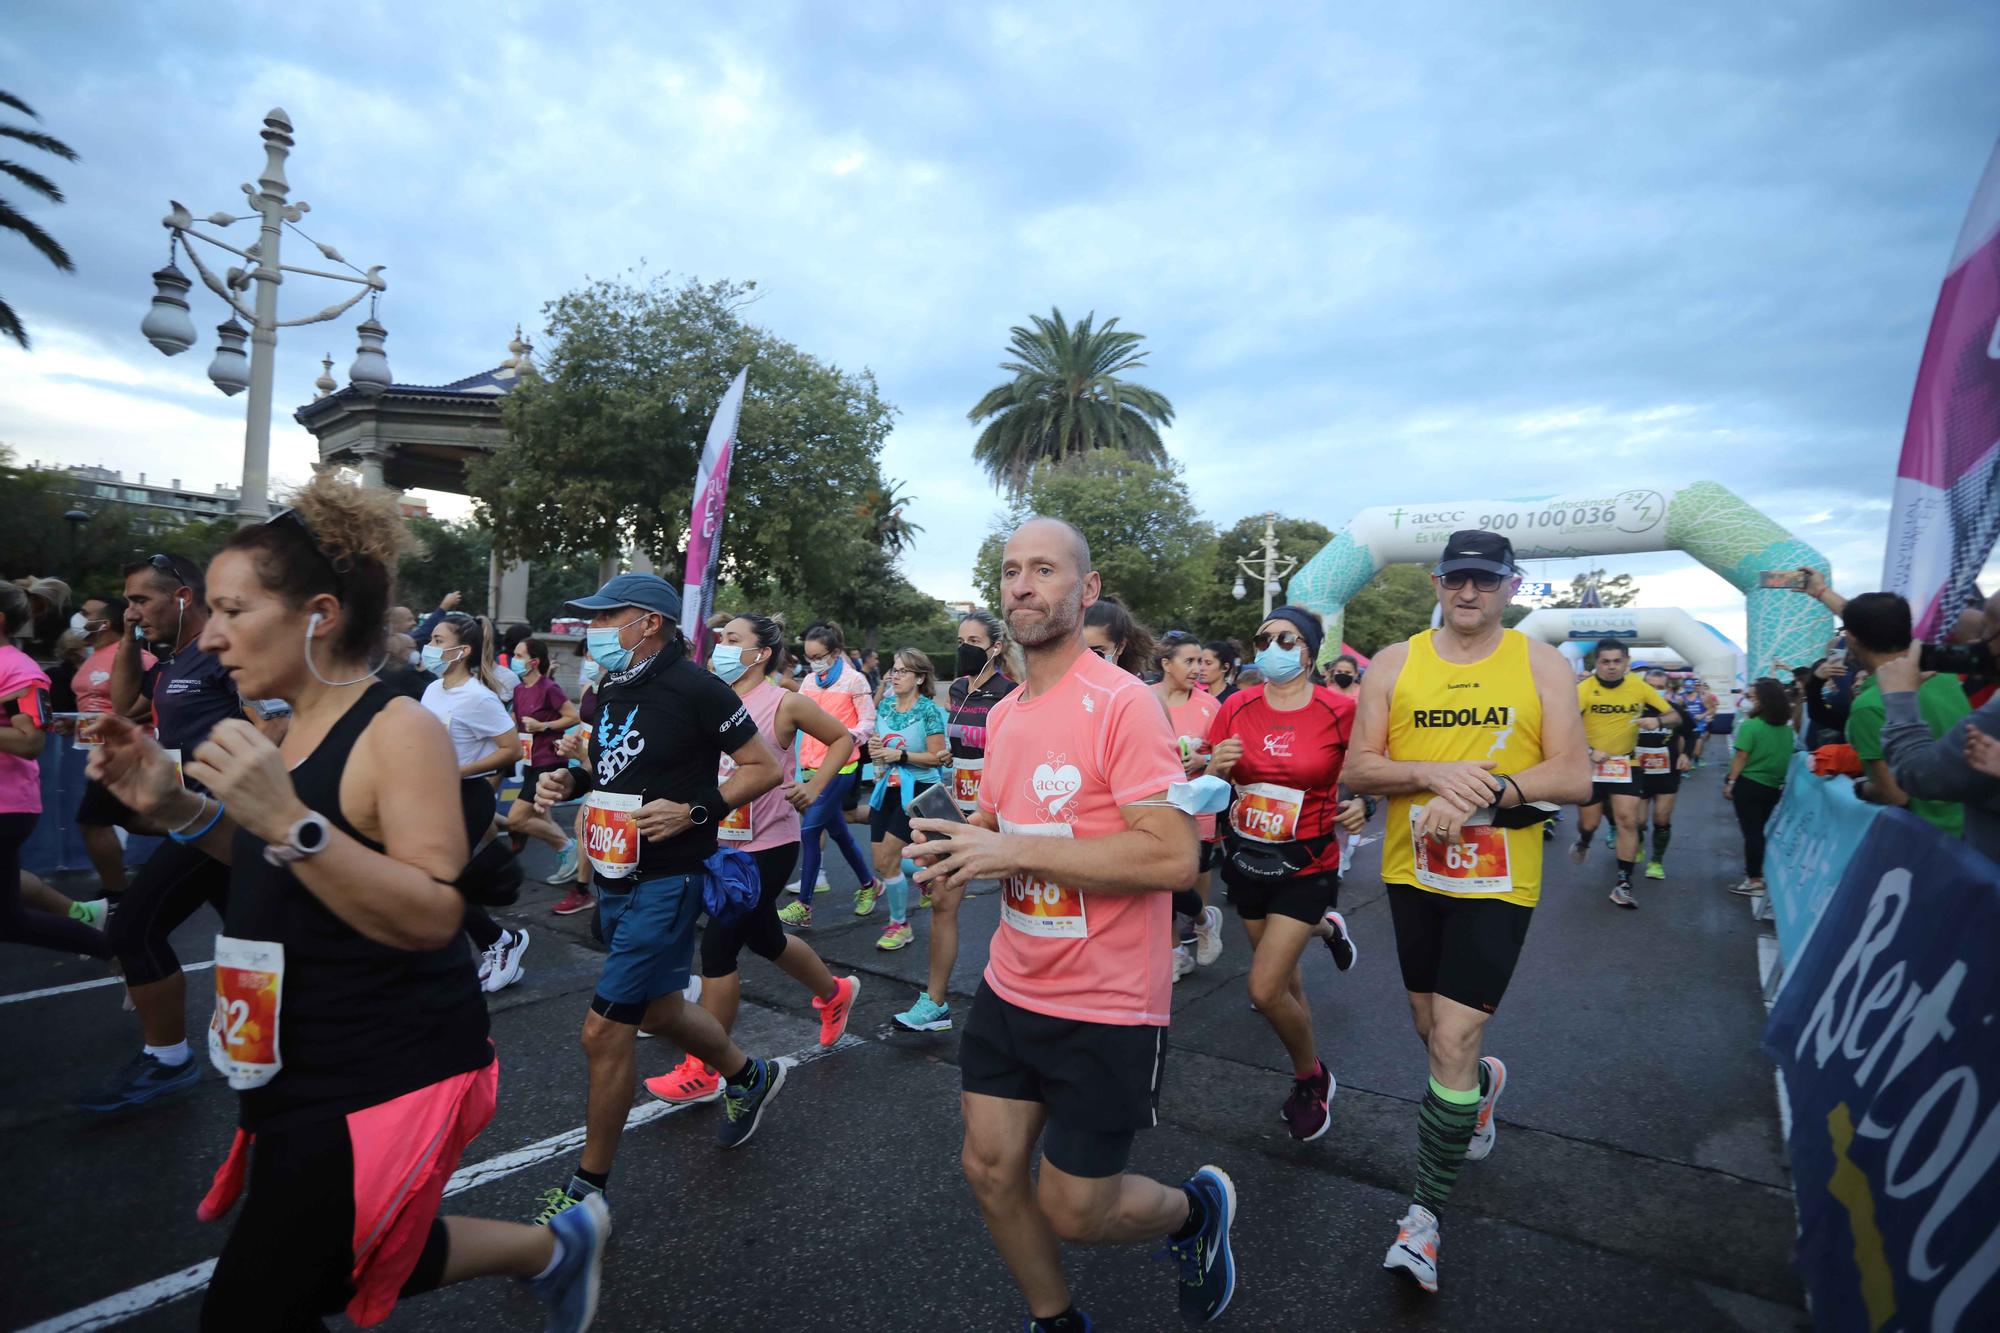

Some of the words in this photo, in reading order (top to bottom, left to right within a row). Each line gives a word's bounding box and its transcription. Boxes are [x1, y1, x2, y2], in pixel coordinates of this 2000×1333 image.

[1411, 507, 1466, 525] aecc
[1478, 512, 1519, 532] 900
[1527, 508, 1567, 529] 100
[1571, 503, 1617, 527] 036
[1432, 529, 1452, 544] Vid
[1413, 705, 1509, 729] REDOLAT
[598, 729, 645, 786] 3FDC
[1036, 777, 1076, 793] aecc
[1245, 807, 1284, 836] 1758
[589, 823, 627, 855] 2084
[1447, 843, 1479, 869] 63
